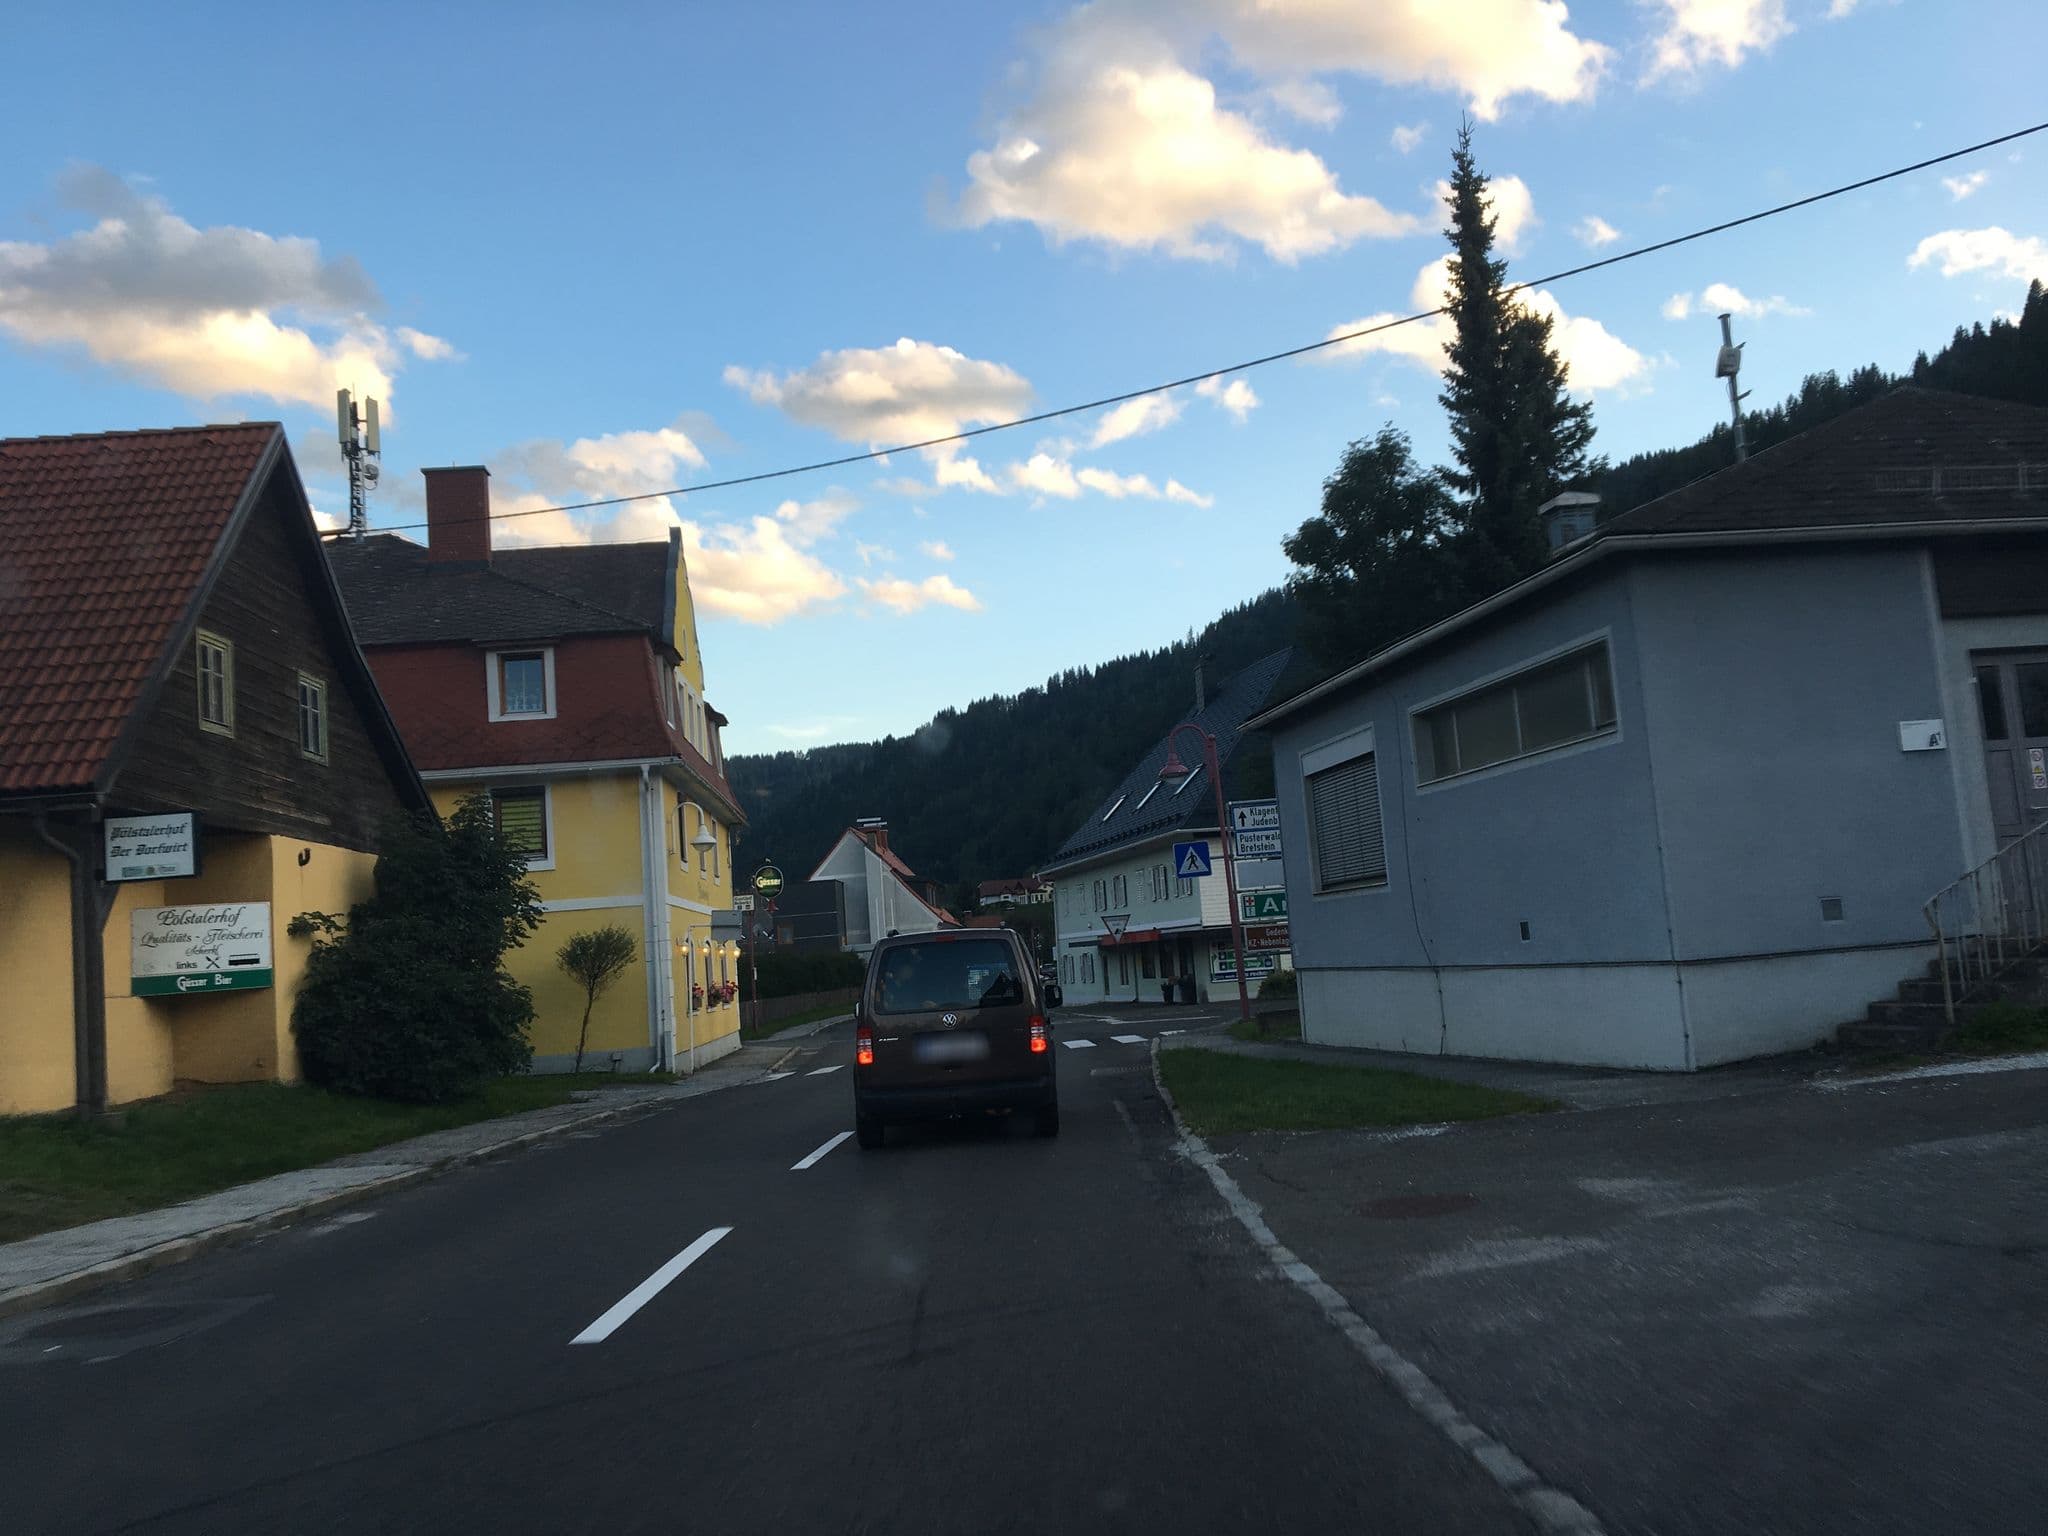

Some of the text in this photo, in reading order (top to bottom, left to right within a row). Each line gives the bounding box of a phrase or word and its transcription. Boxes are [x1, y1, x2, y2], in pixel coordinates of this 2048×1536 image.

[1251, 816, 1278, 826] Judenb
[110, 843, 188, 857] Der Dorfwirt
[1240, 842, 1275, 853] Bretstein
[756, 877, 780, 888] Gösser
[157, 906, 246, 927] Pölstalerhof
[202, 927, 264, 945] Fleischerei
[176, 961, 198, 970] links
[176, 974, 232, 992] Gösser Bier
